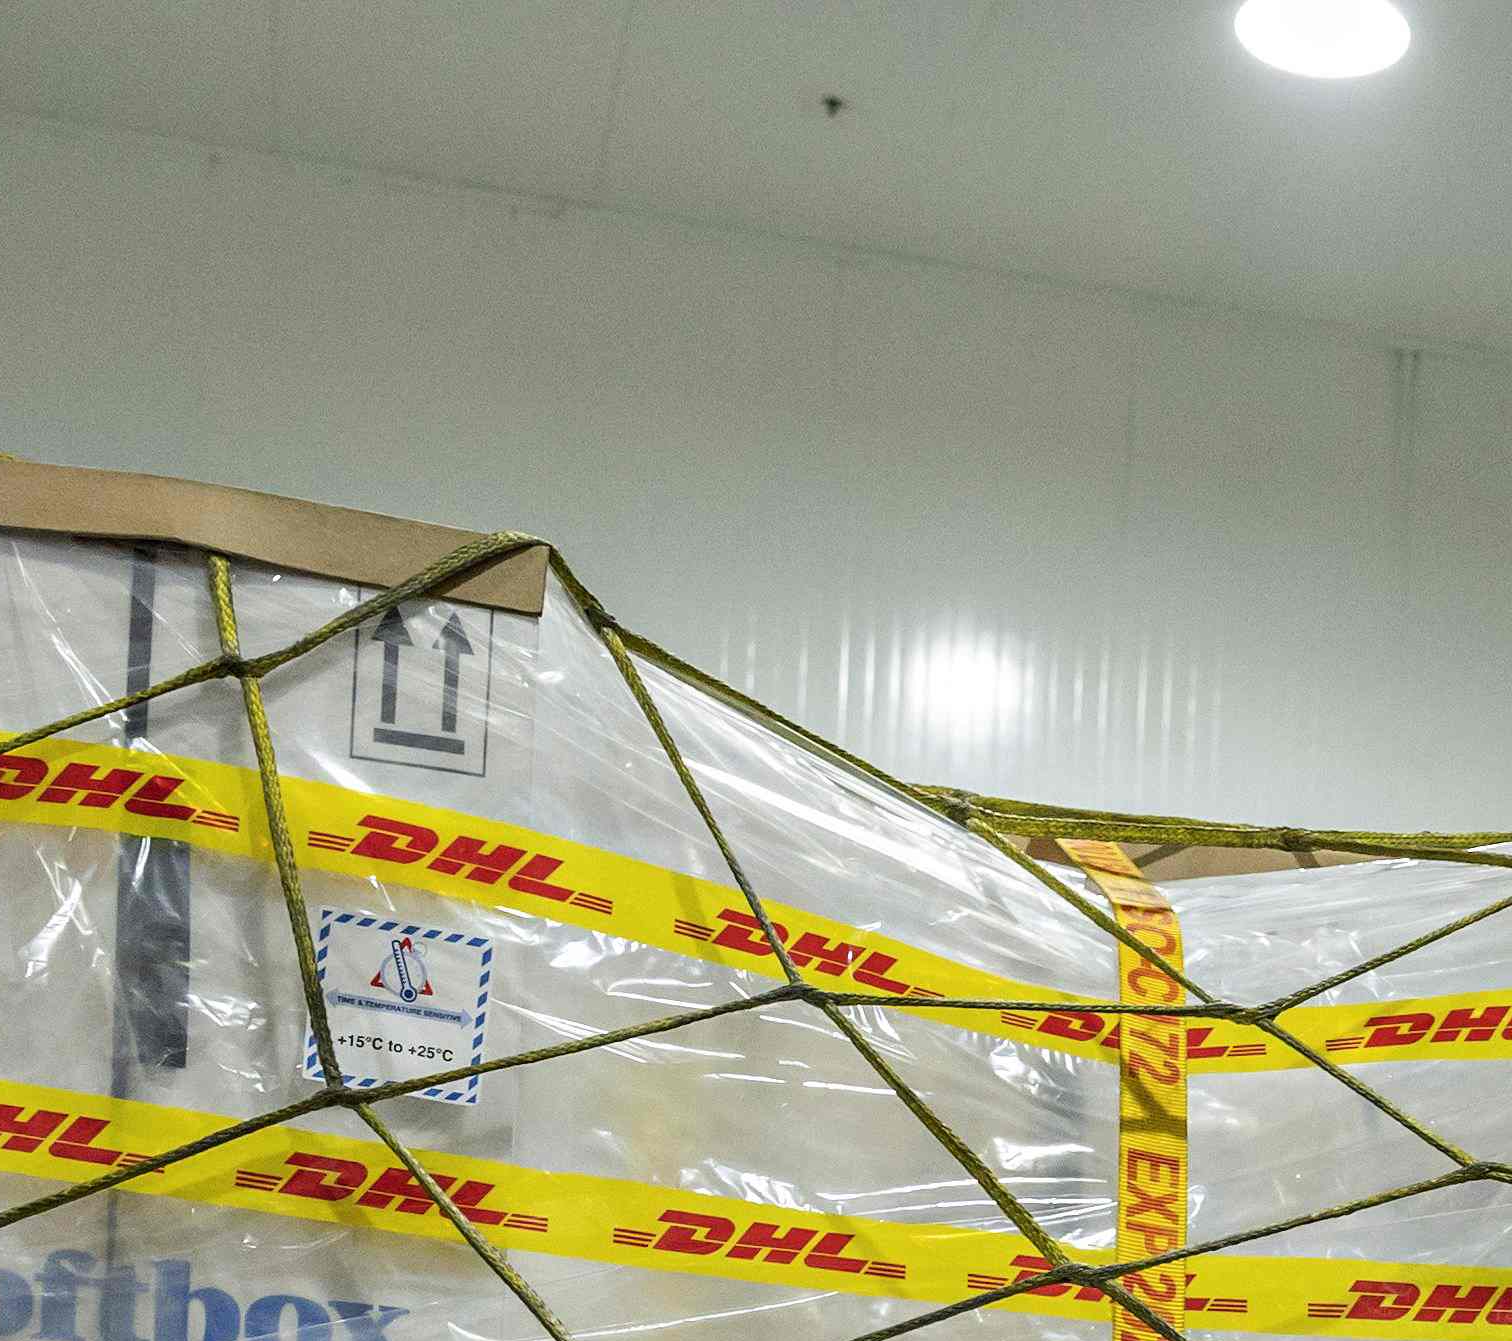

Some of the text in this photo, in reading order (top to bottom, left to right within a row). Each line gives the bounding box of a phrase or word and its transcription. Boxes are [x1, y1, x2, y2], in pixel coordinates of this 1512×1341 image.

[353, 816, 571, 900] DHL
[714, 910, 905, 993] DHL
[337, 1034, 454, 1063] +15°C to +25°C
[364, 1000, 422, 1016] TEMPERATURE
[284, 1153, 503, 1223] DHL
[656, 1212, 863, 1272] DHL
[1124, 1150, 1183, 1265] EXP
